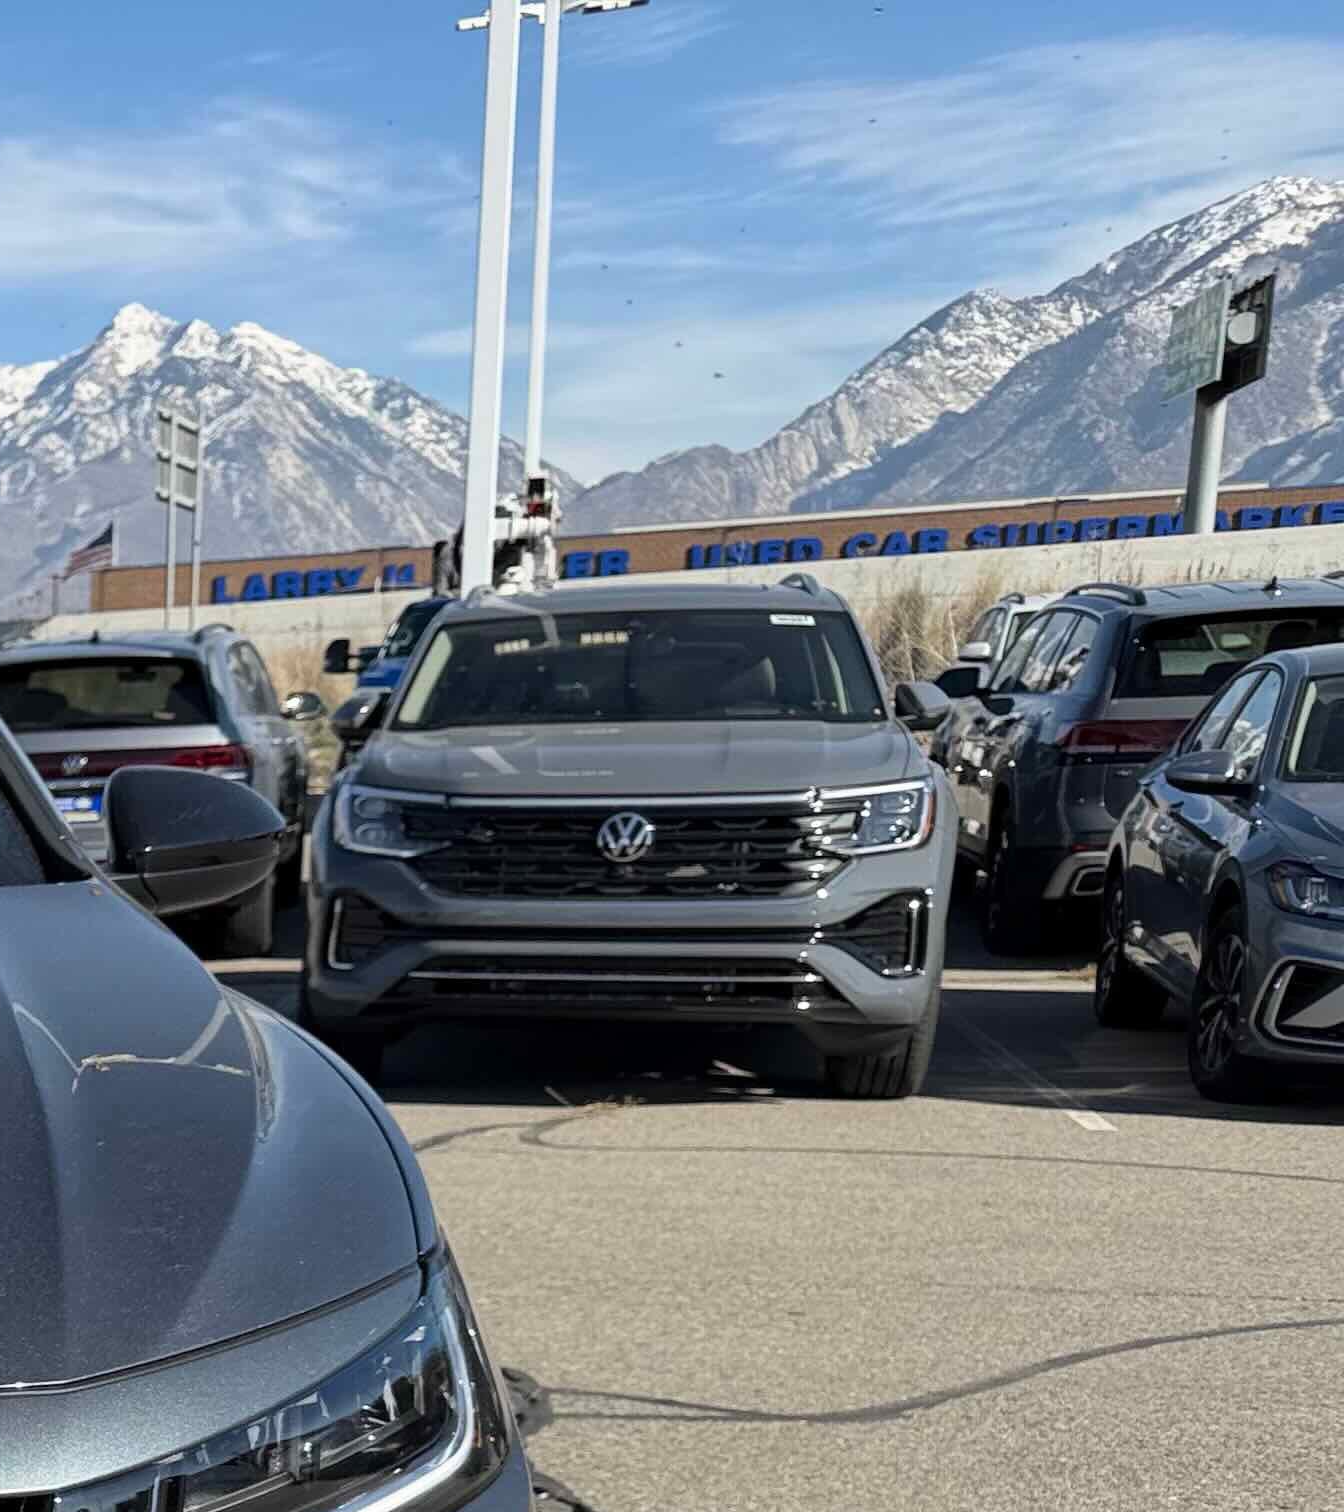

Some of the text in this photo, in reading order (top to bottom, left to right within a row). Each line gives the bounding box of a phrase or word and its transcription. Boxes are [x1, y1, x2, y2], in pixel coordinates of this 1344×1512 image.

[688, 536, 823, 569] USED
[841, 528, 949, 558] CAR
[212, 565, 365, 604] LARRY
[598, 812, 653, 861] VW
